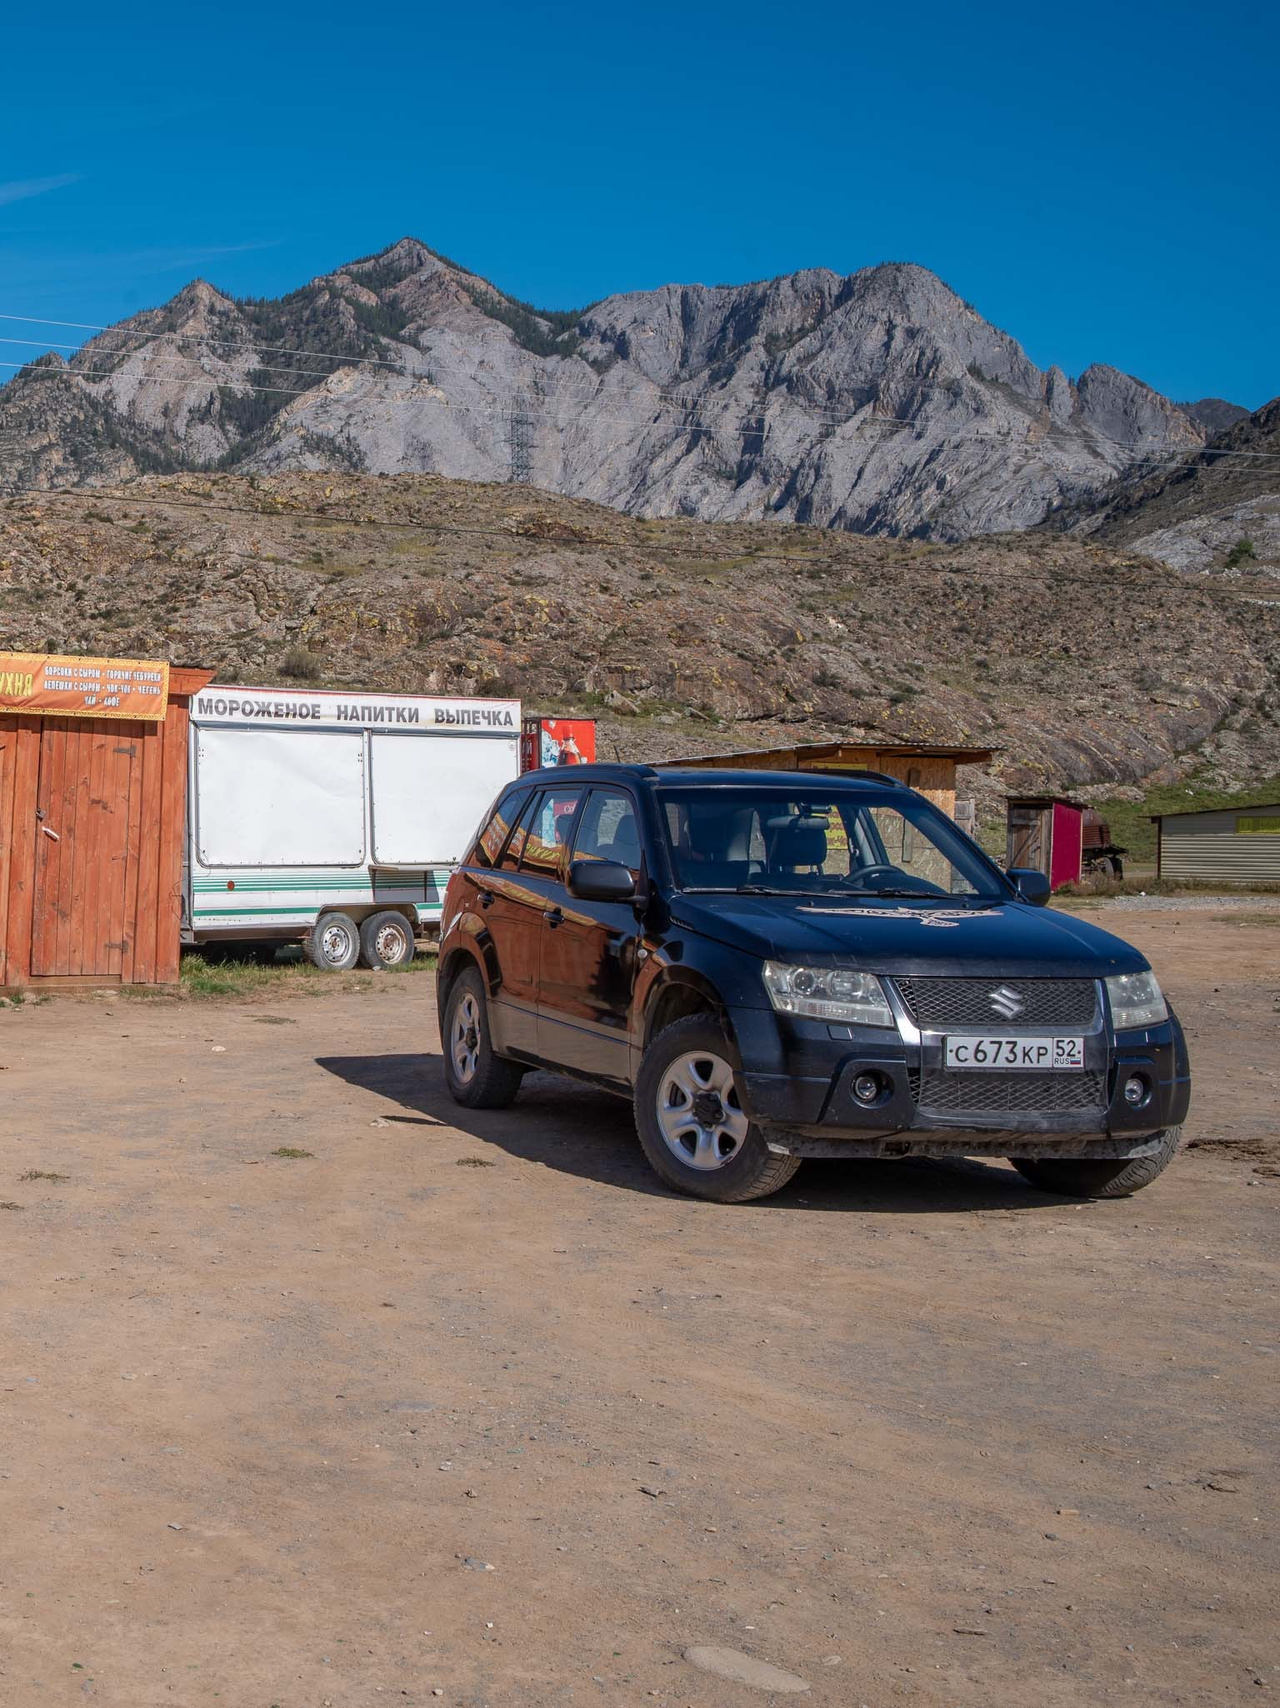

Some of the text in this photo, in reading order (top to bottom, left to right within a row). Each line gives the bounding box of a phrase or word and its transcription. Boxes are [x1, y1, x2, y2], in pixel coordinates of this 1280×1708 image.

[198, 698, 513, 726] МОРОЖЕНОЕ НАПИТКИ ВЫПЕЧКА
[955, 1040, 1048, 1064] С673КР
[1056, 1040, 1076, 1057] 52
